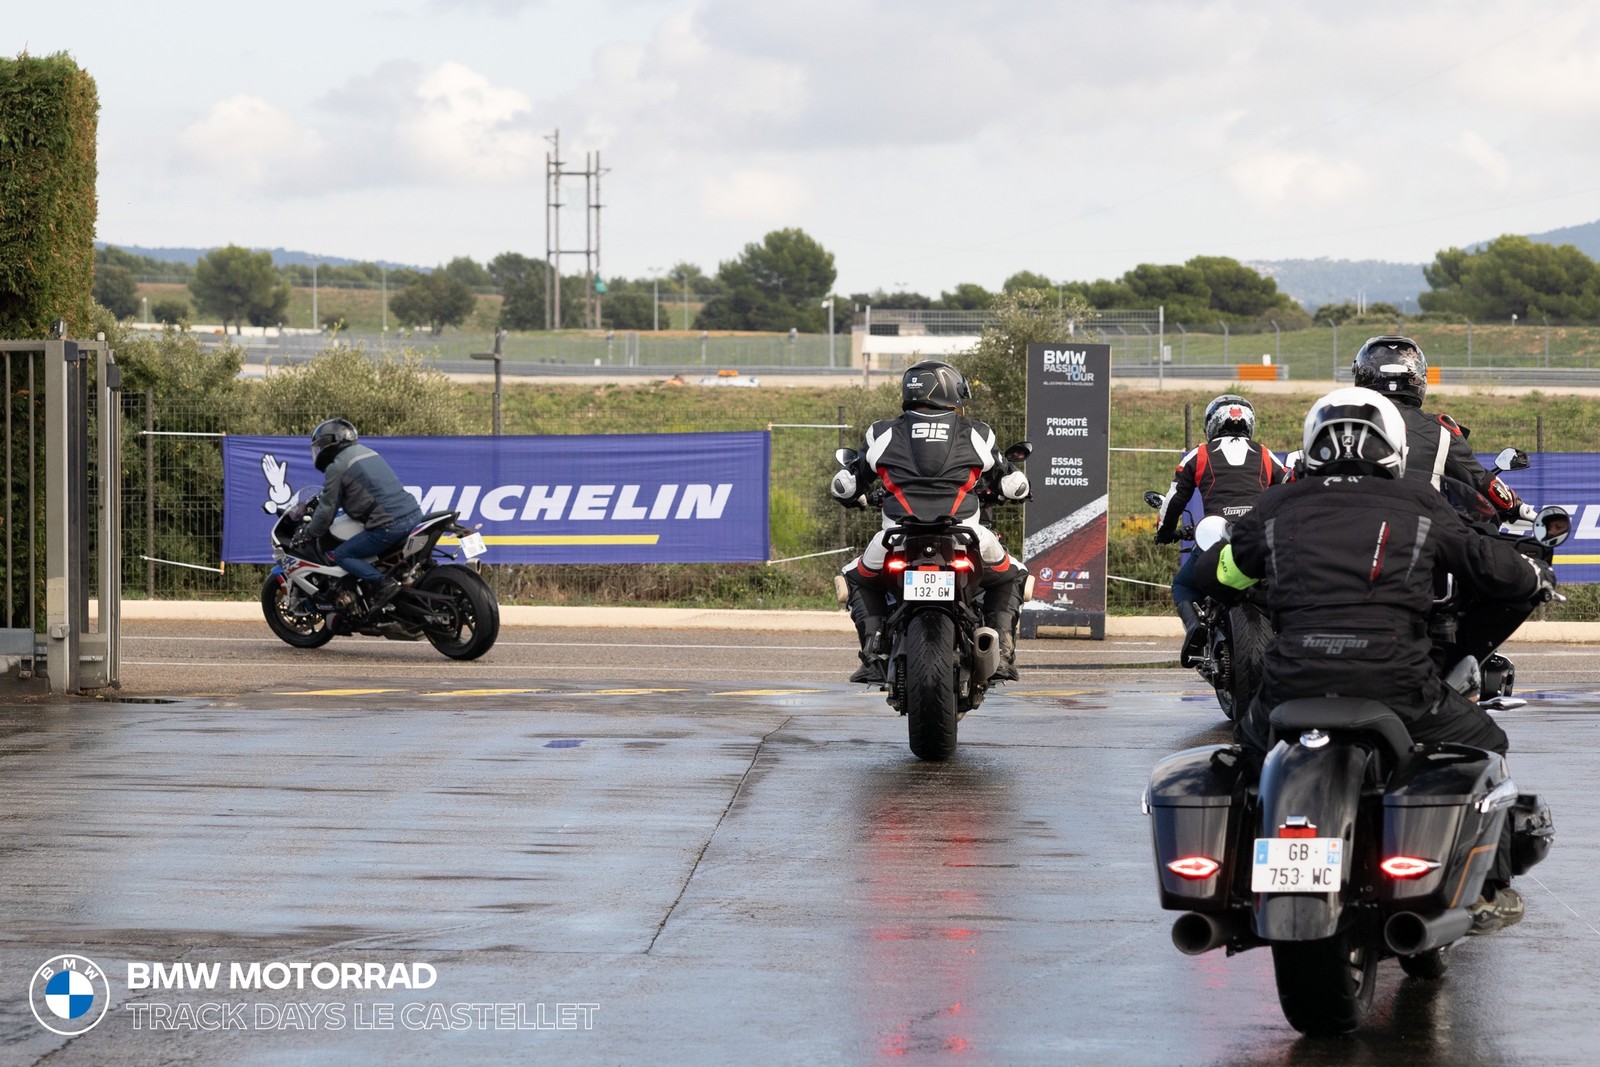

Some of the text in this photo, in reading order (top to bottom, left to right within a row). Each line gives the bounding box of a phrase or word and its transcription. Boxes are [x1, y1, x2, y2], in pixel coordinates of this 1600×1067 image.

[1043, 350, 1086, 364] BMW
[1043, 364, 1086, 373] PASSION
[1066, 373, 1094, 381] TOUR
[1046, 417, 1088, 427] PRIORITÉ
[1047, 426, 1089, 437] À DROITE
[1051, 457, 1083, 466] ESSAIS
[1051, 467, 1083, 476] MOTOS
[1045, 477, 1089, 487] EN COURS
[402, 484, 733, 521] MICHELIN
[924, 573, 936, 584] GD
[938, 586, 950, 598] GW
[1289, 843, 1309, 861] GB
[1312, 867, 1332, 885] WC
